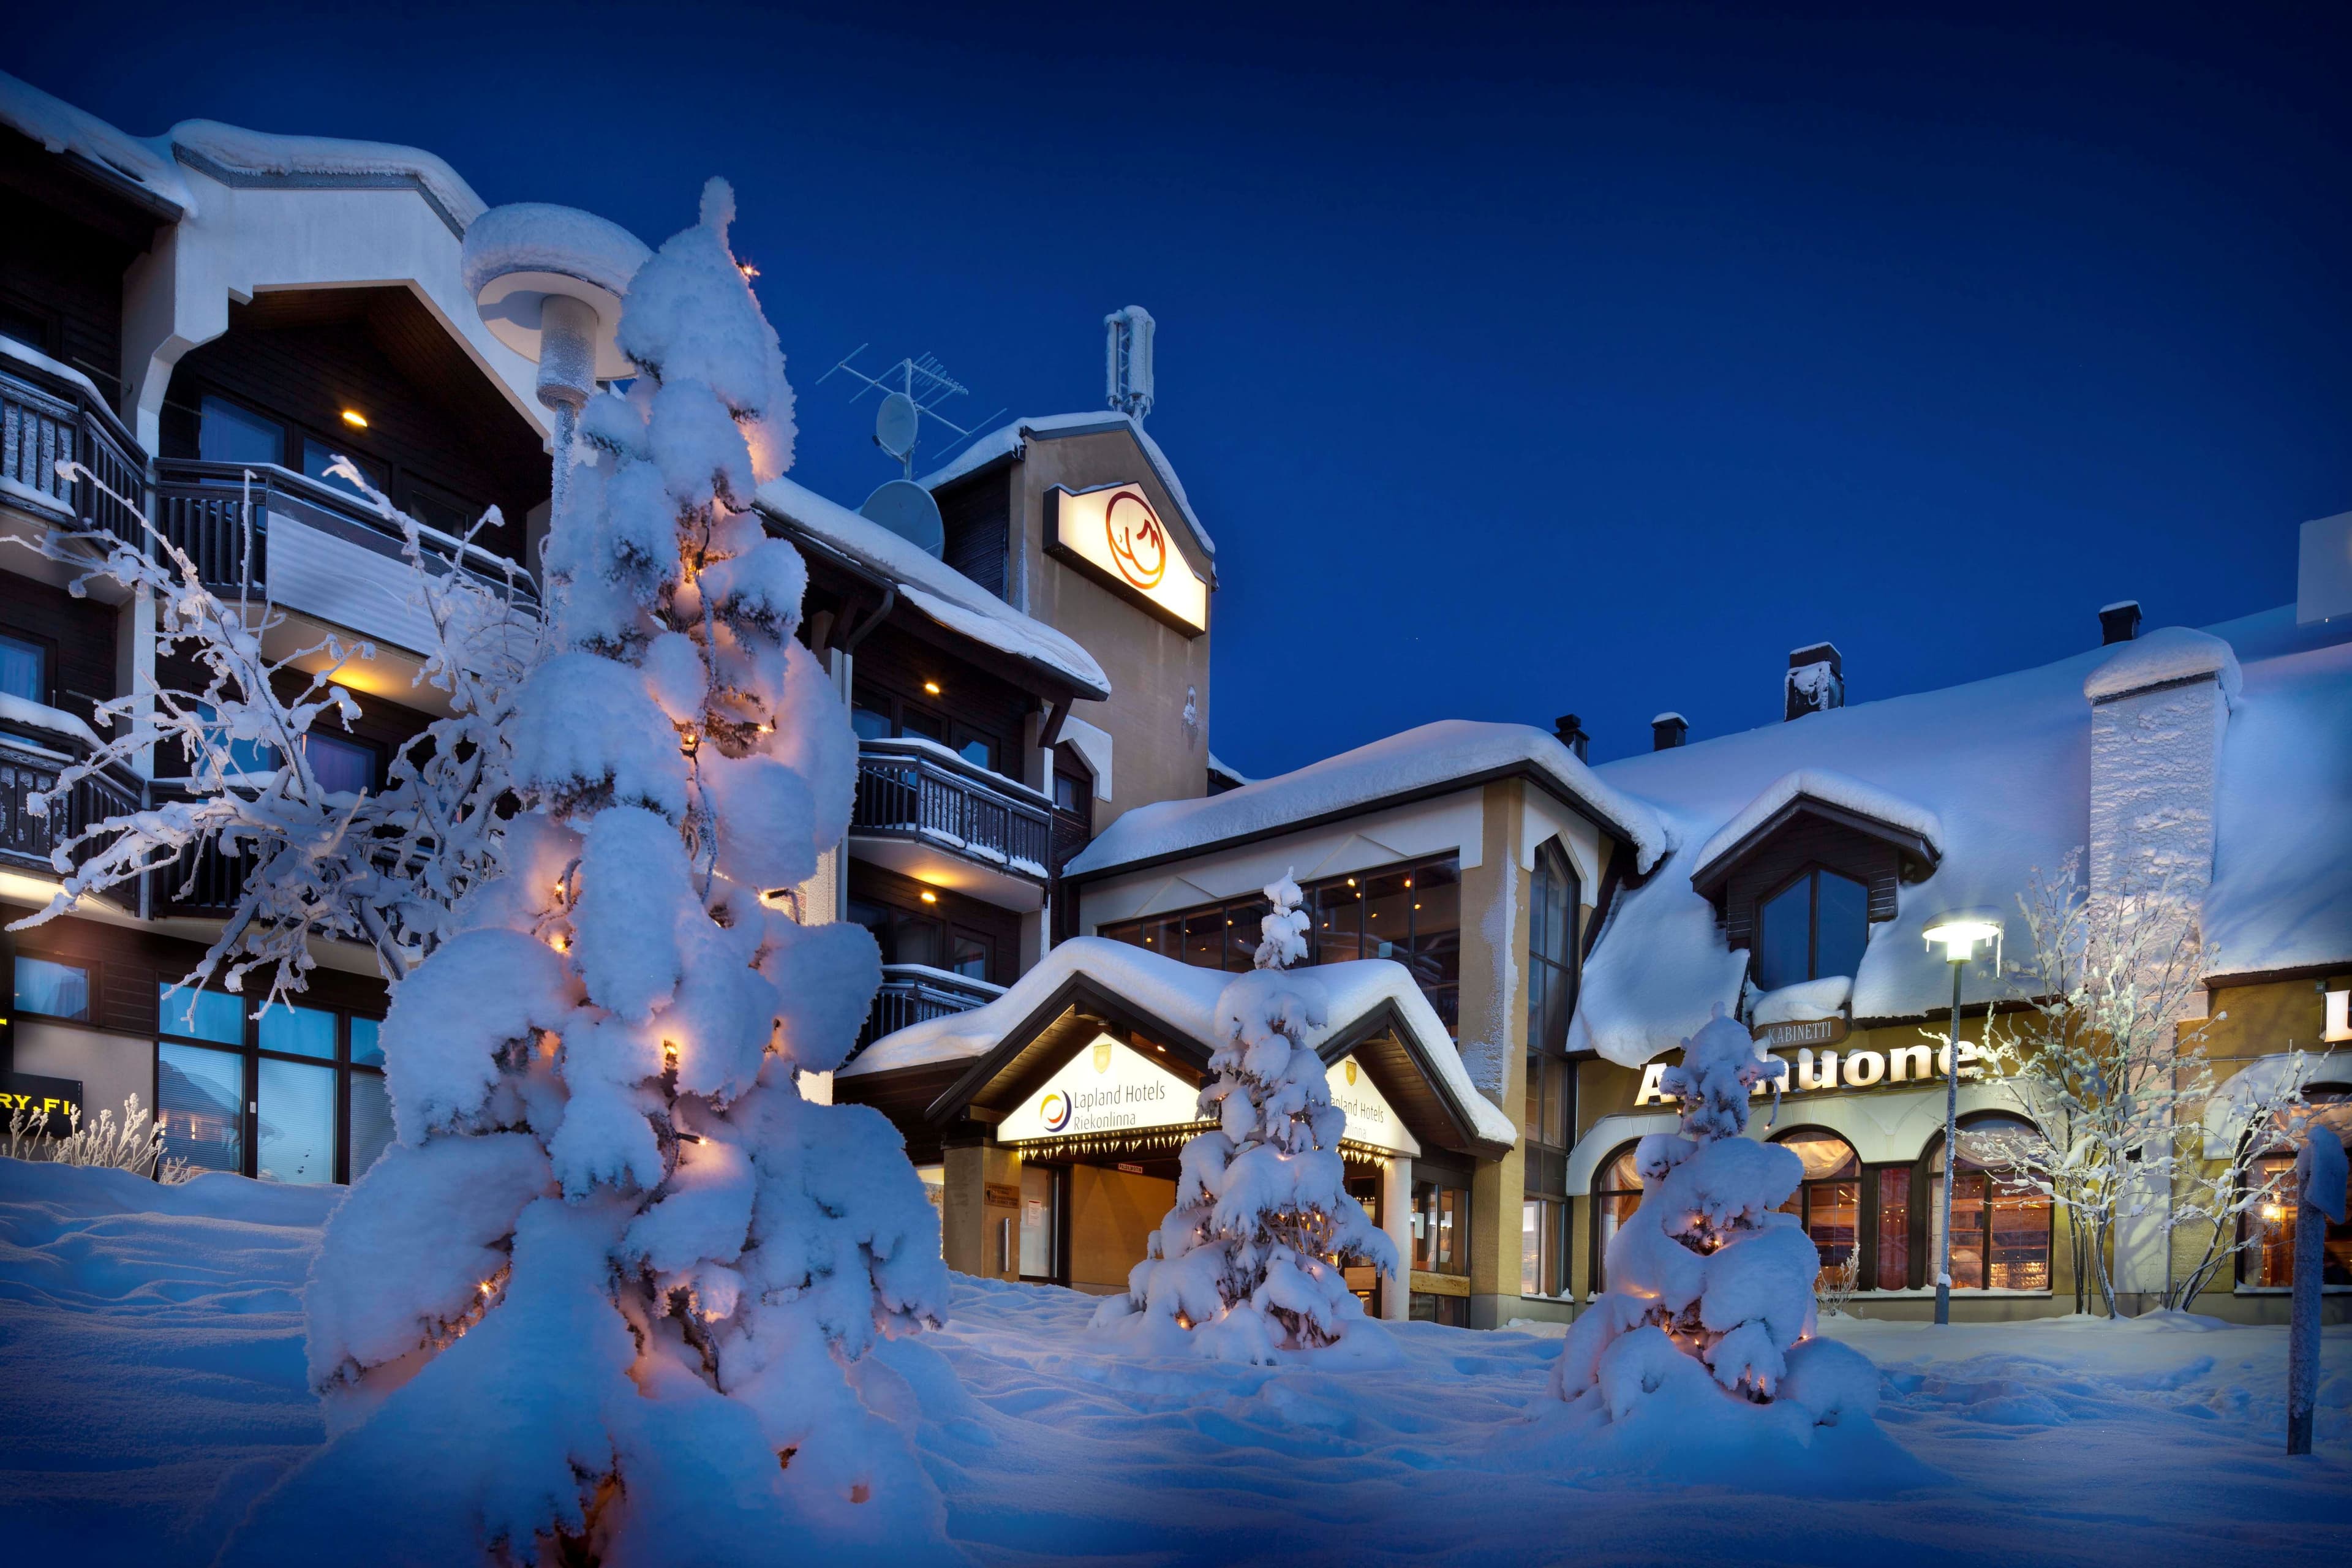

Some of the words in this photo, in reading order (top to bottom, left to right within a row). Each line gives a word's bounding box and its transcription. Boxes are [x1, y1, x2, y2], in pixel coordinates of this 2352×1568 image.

[1768, 1021, 1831, 1043] KABINETTI
[1074, 1084, 1120, 1112] Lapland
[1126, 1080, 1165, 1102] Hotels
[1331, 1094, 1357, 1116] aland
[1360, 1102, 1384, 1123] Hotels
[1074, 1112, 1136, 1131] Riekonlinna
